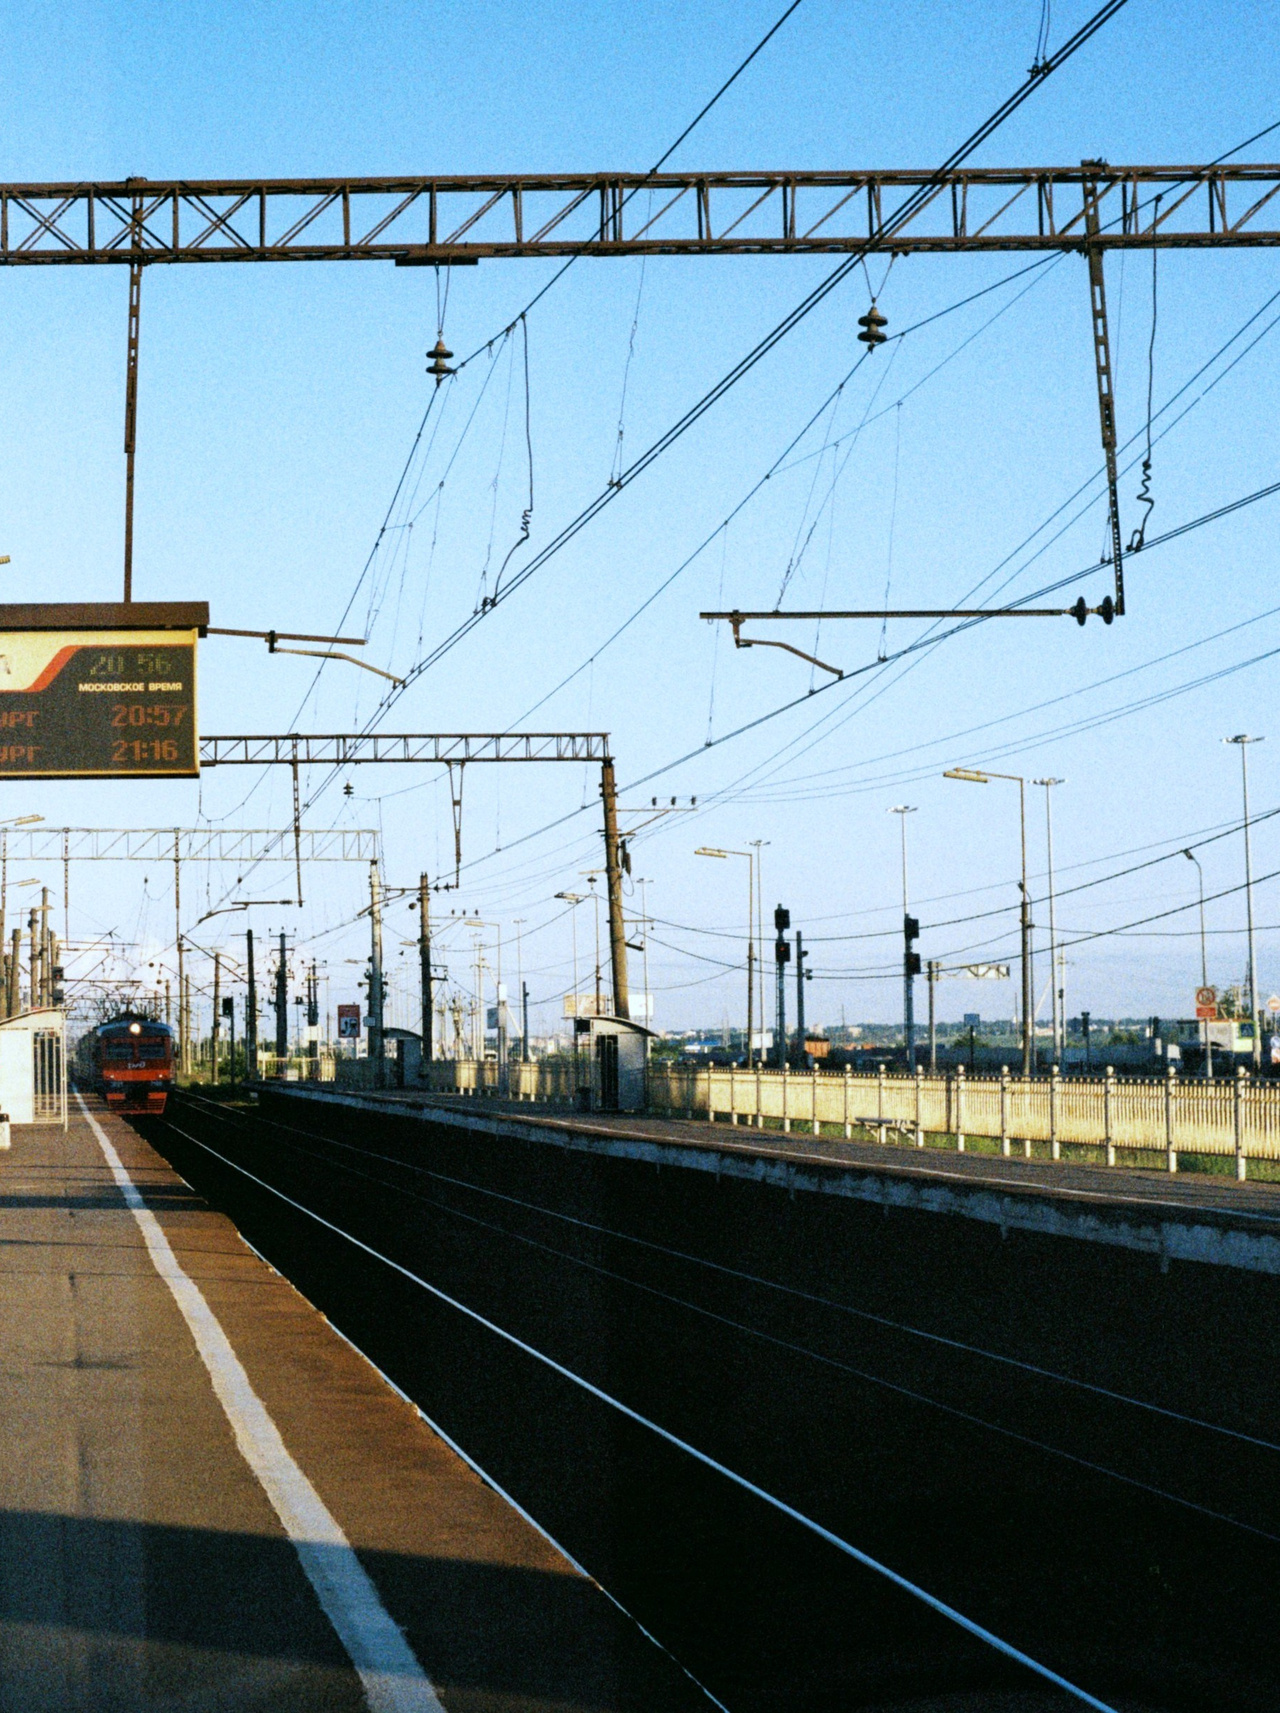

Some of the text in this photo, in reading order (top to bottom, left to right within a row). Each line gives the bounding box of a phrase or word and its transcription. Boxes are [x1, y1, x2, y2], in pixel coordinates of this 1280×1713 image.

[78, 682, 183, 692] МОСКОВСКОЕ ВРЕМЯ
[110, 704, 188, 727] 20:57
[111, 739, 179, 762] 21:16
